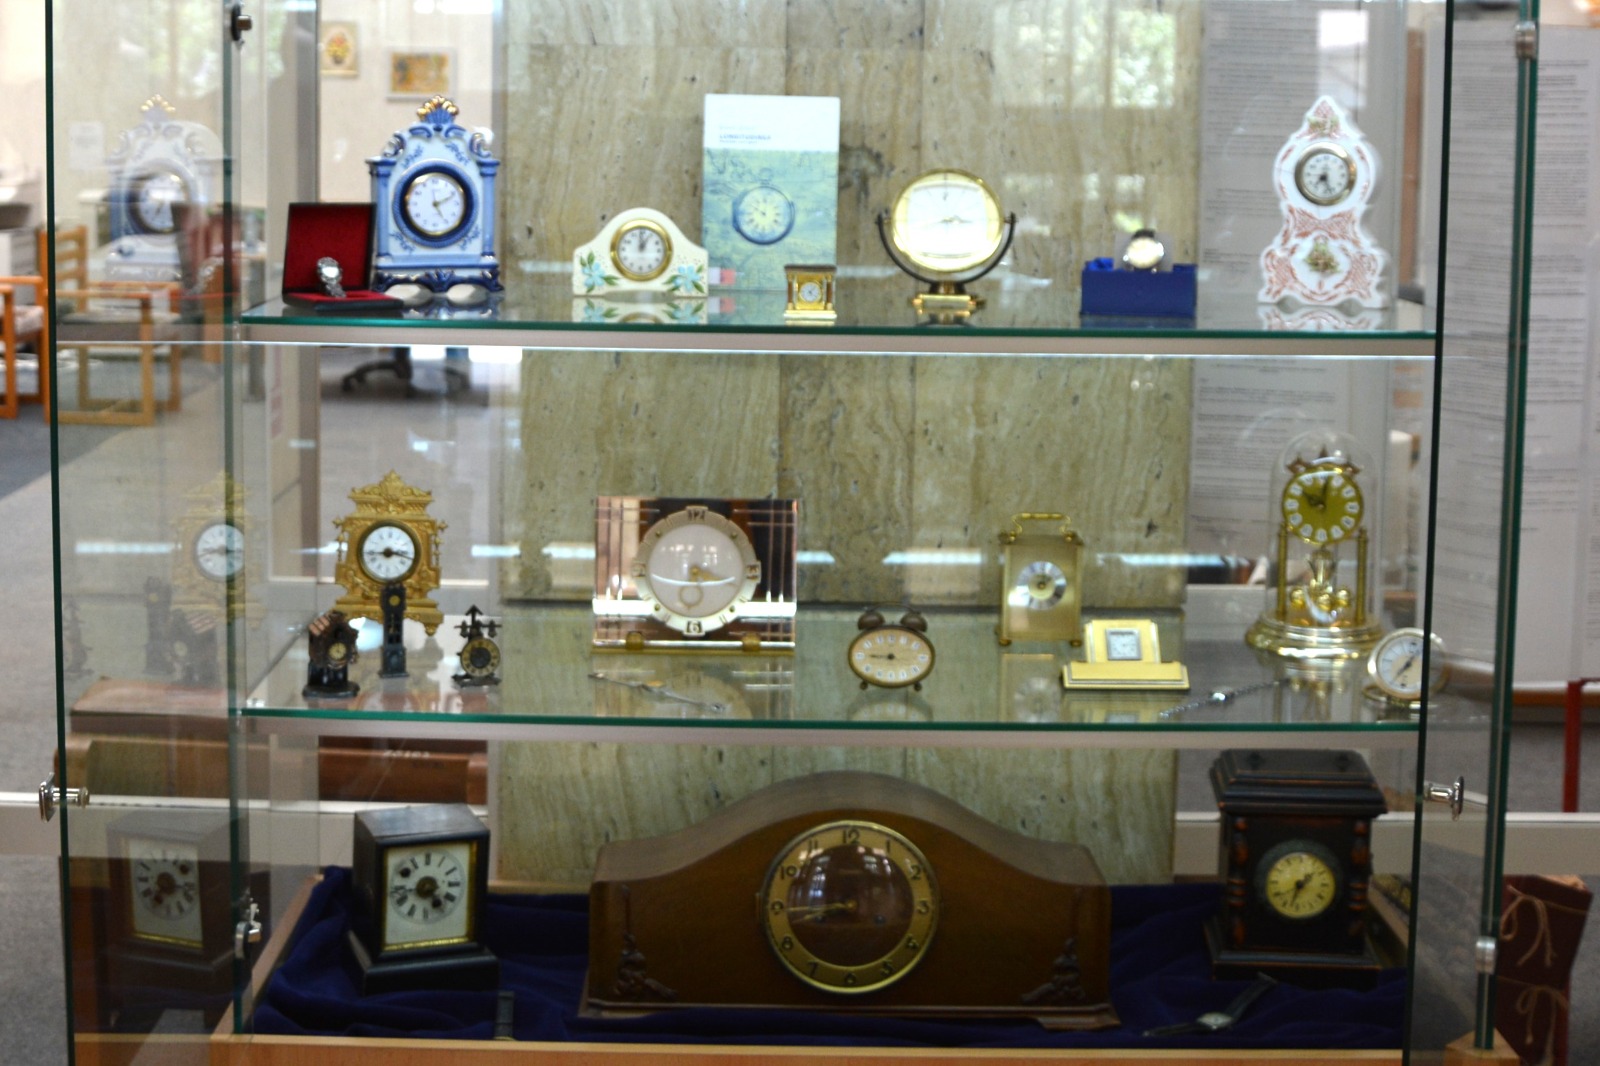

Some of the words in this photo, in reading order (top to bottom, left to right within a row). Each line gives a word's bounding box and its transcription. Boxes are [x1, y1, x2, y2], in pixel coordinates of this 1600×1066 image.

[688, 621, 701, 633] 6
[843, 828, 860, 845] 12
[780, 864, 798, 880] 10
[910, 864, 922, 880] 2
[771, 900, 784, 915] 9
[917, 900, 930, 915] 3
[781, 936, 793, 950] 8
[907, 936, 918, 950] 4
[808, 962, 819, 977] 7
[881, 961, 893, 976] 5
[845, 971, 857, 985] 6
